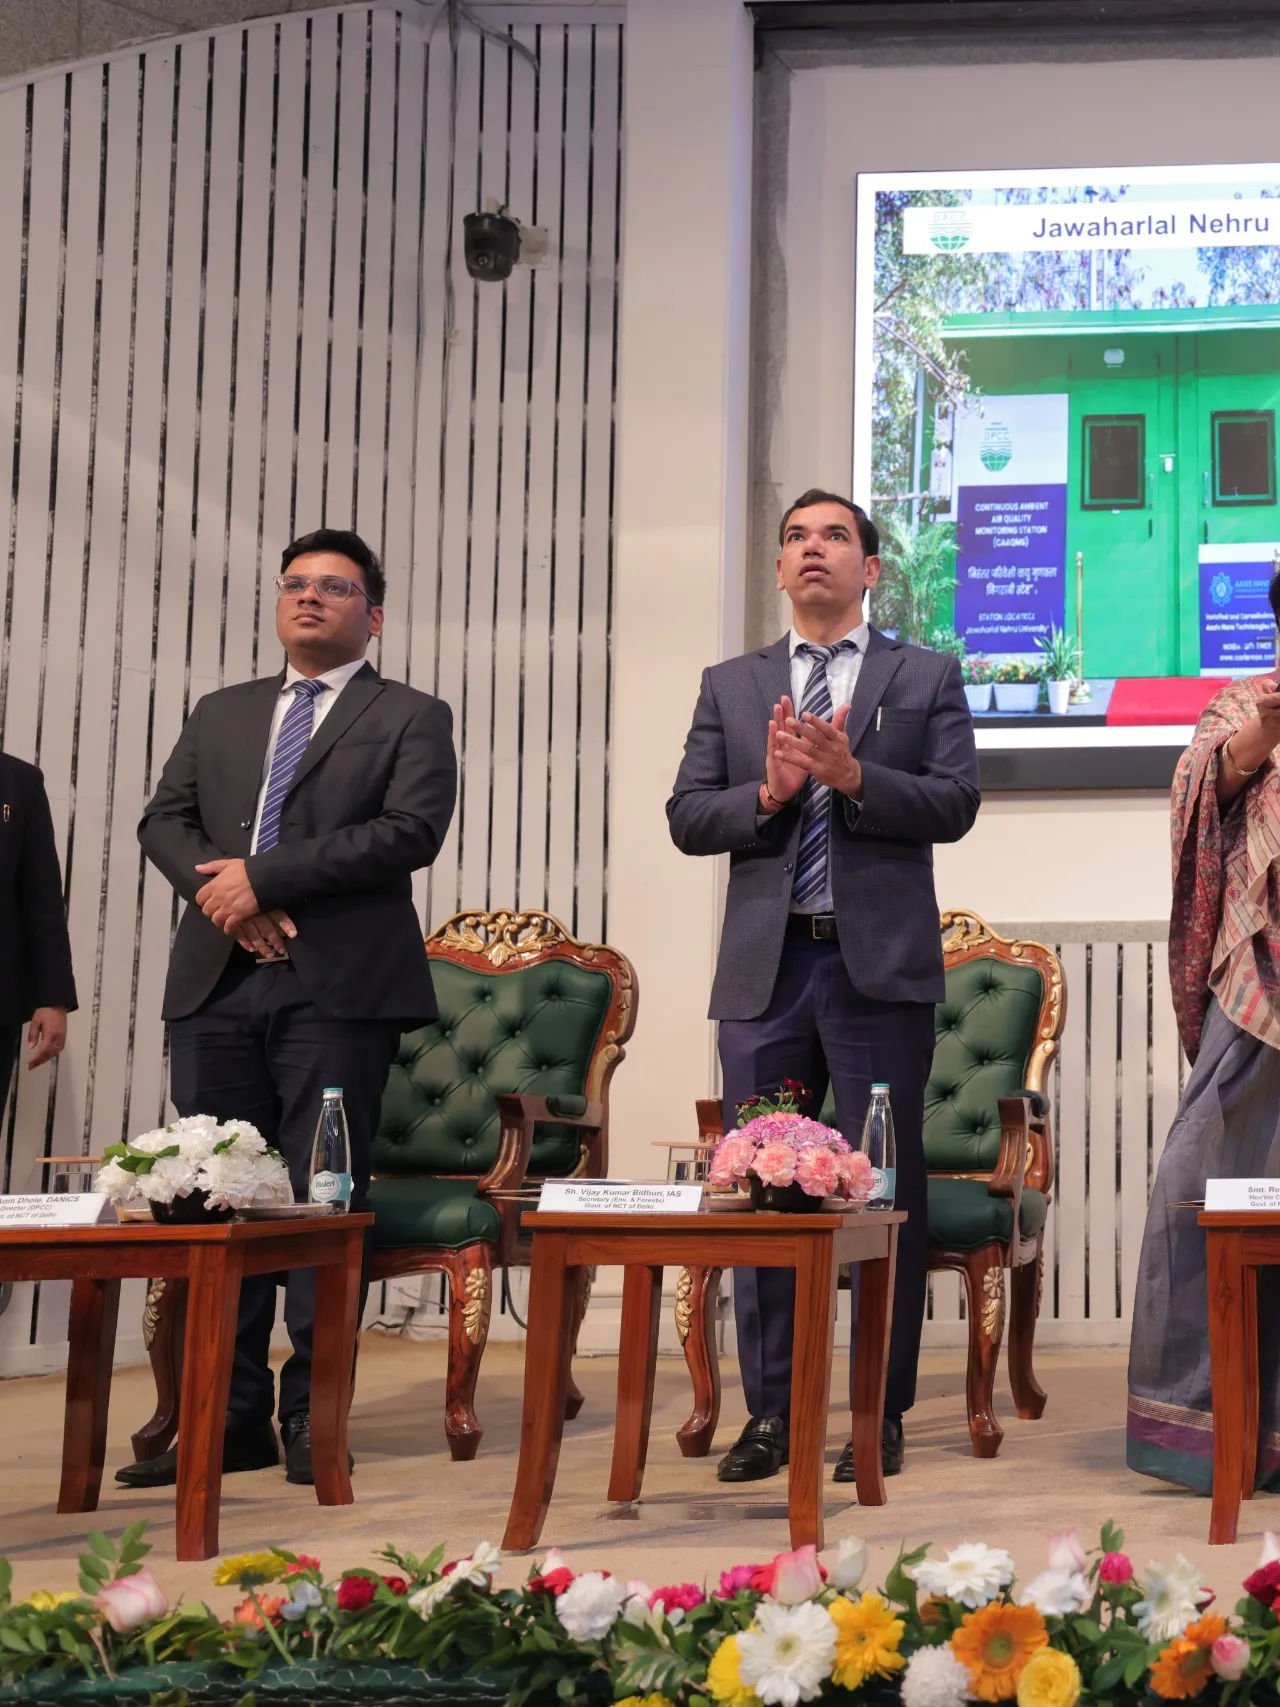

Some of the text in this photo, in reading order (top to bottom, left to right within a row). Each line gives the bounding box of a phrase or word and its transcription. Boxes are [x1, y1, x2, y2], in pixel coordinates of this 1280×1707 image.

[1032, 214, 1176, 238] Jawaharlal
[1189, 212, 1269, 234] Nehru
[974, 501, 1049, 512] CONTINUOUS AMBIENT
[1003, 513, 1032, 524] QUALITY
[975, 525, 1048, 535] MONITORING STATION
[580, 1188, 601, 1197] Vijay
[603, 1188, 630, 1196] Kumar
[632, 1189, 664, 1197] Bidhuri,
[46, 1195, 80, 1203] DANICS
